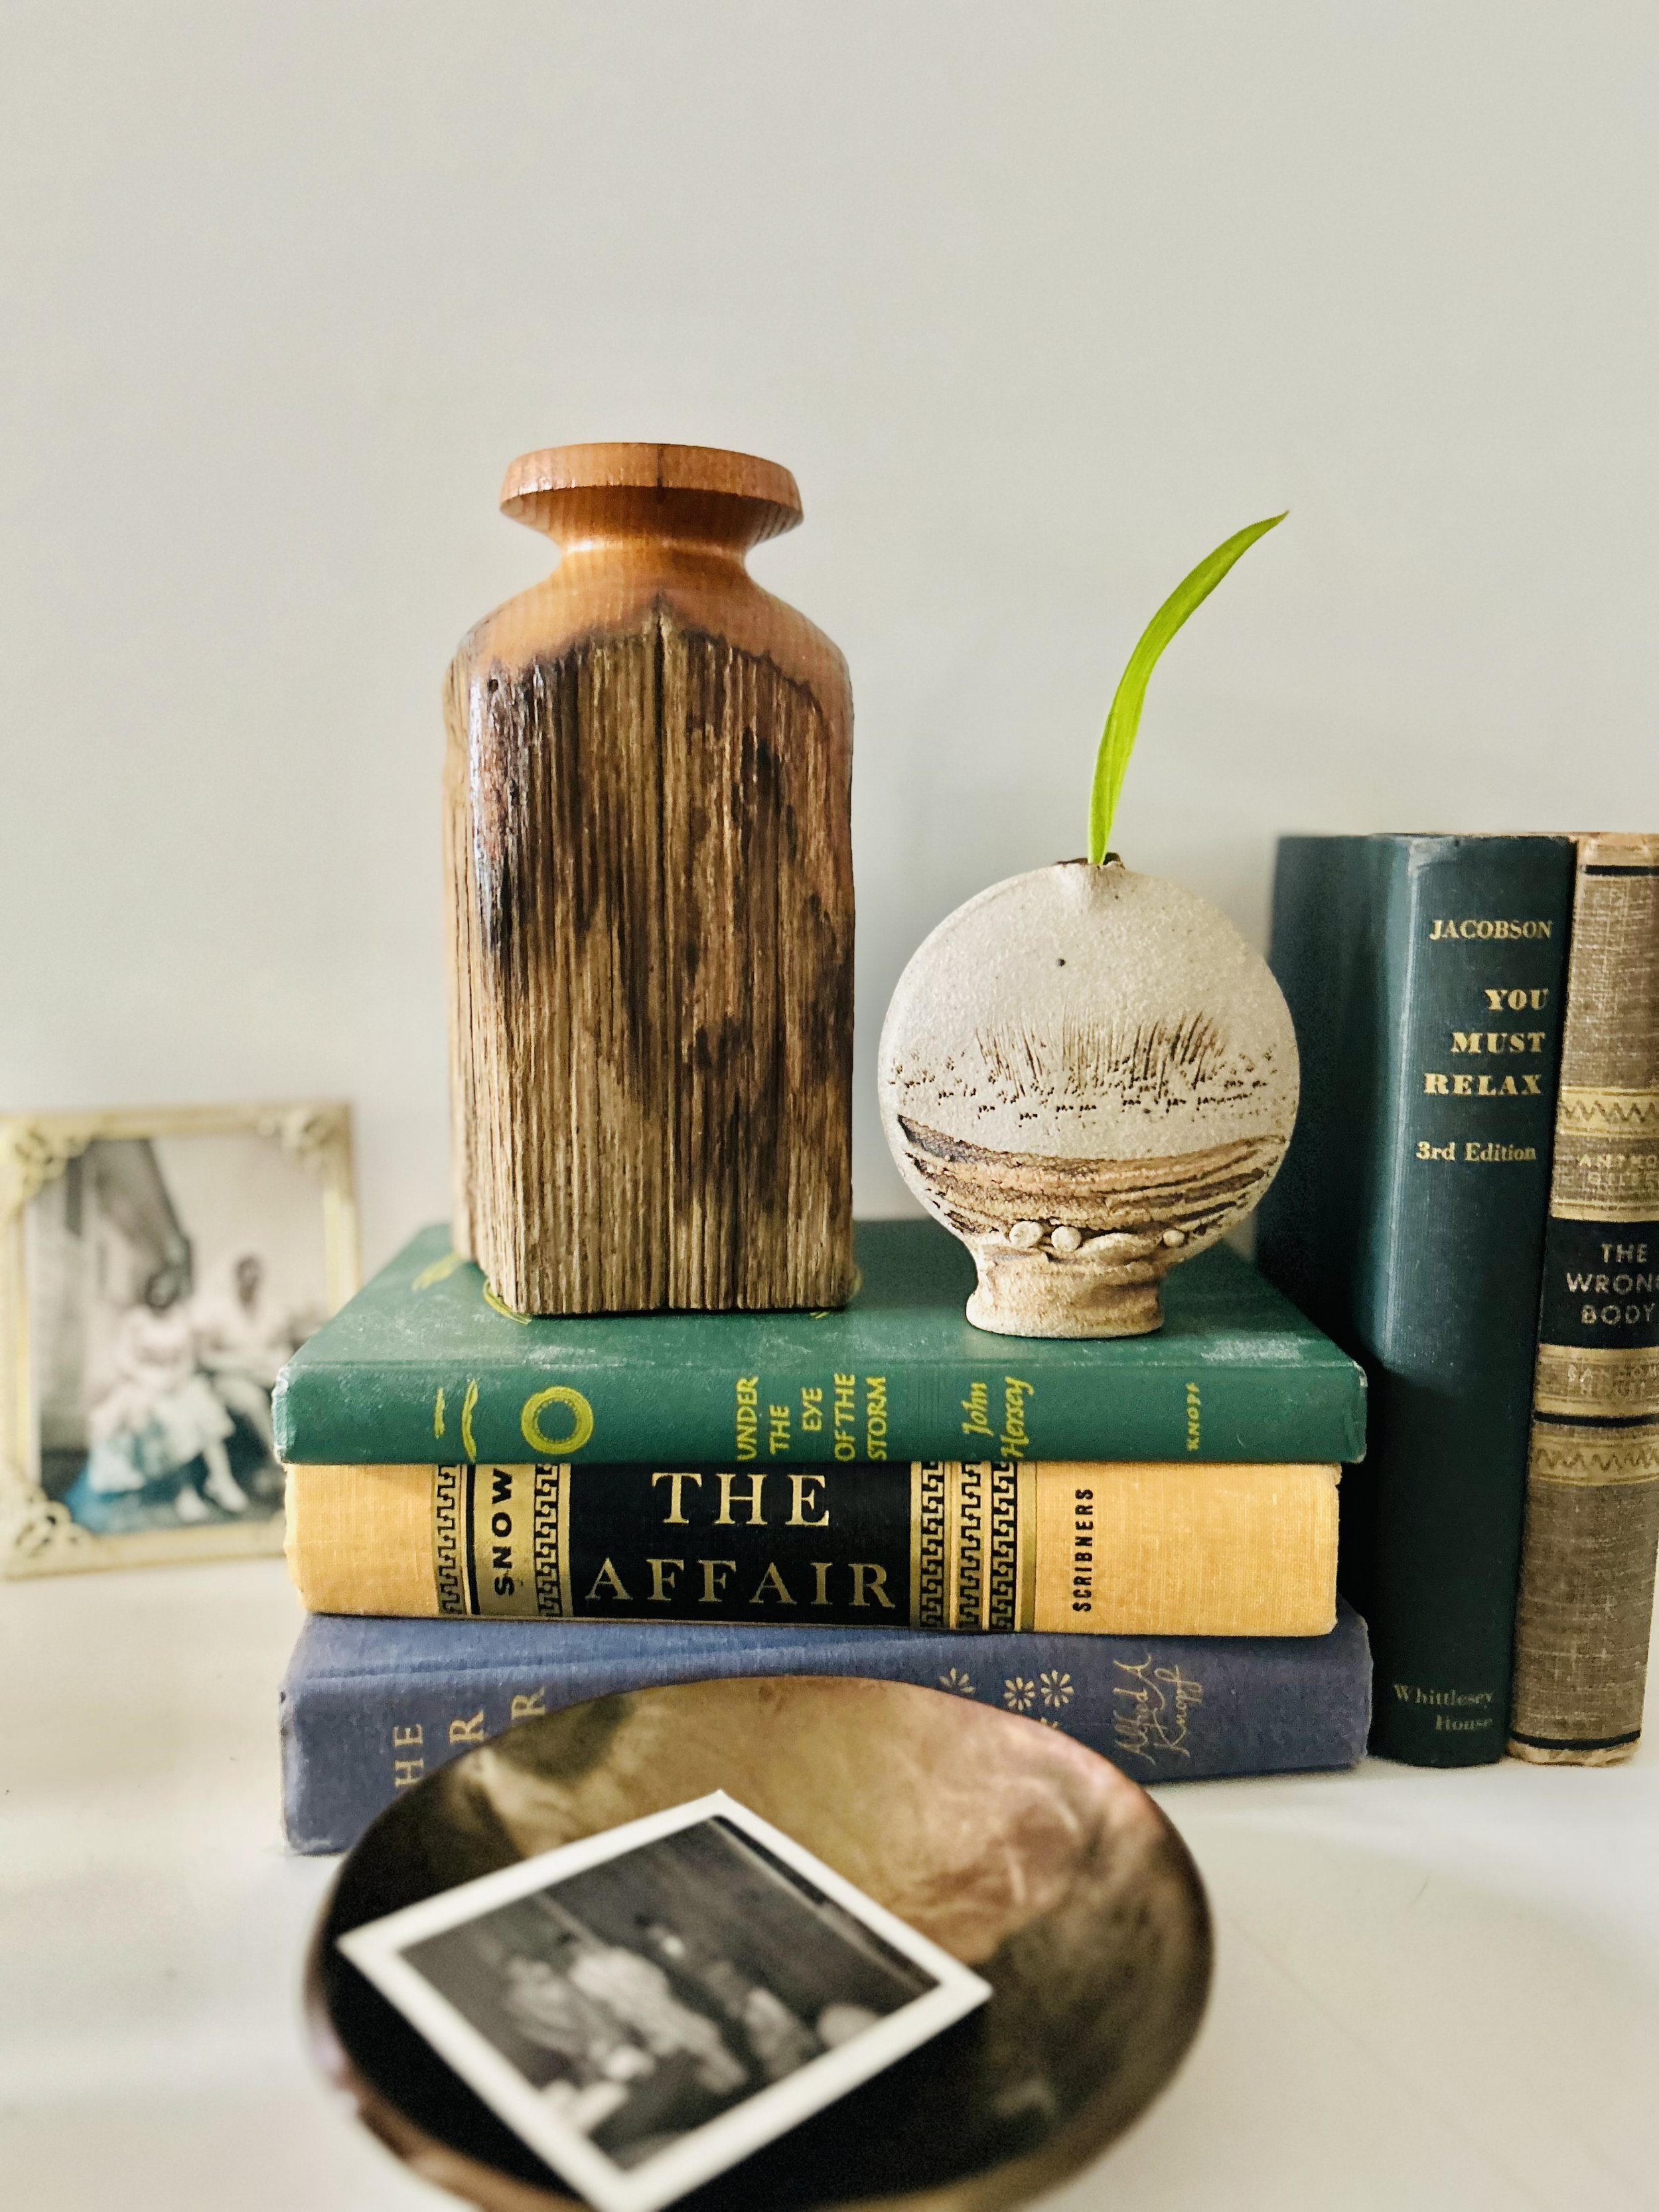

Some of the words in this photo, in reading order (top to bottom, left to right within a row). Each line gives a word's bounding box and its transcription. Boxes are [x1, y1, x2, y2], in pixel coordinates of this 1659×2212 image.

[1429, 919, 1552, 941] JACOBSON
[1484, 988, 1550, 1011] YOU
[1451, 1032, 1546, 1054] MUST
[1423, 1072, 1542, 1096] RELAX
[1416, 1142, 1455, 1161] 3rd
[1465, 1142, 1536, 1162] Edition
[1601, 1243, 1648, 1264] THE
[1581, 1302, 1656, 1325] BODY
[735, 1376, 759, 1461] UNDER
[800, 1387, 823, 1432] EYE
[833, 1372, 855, 1427] THE
[865, 1376, 887, 1461] STORM
[961, 1382, 995, 1437] John
[999, 1376, 1035, 1458] Hersey
[1185, 1382, 1201, 1451] KNOPF
[768, 1404, 791, 1455] THE
[833, 1428, 856, 1462] OF
[652, 1471, 830, 1528] THE
[491, 1467, 515, 1597] SNOW
[1072, 1489, 1094, 1613] SCRIBNERS
[585, 1556, 897, 1609] AFFAIR
[1152, 1664, 1202, 1758] Knopf
[392, 1723, 425, 1788] HE
